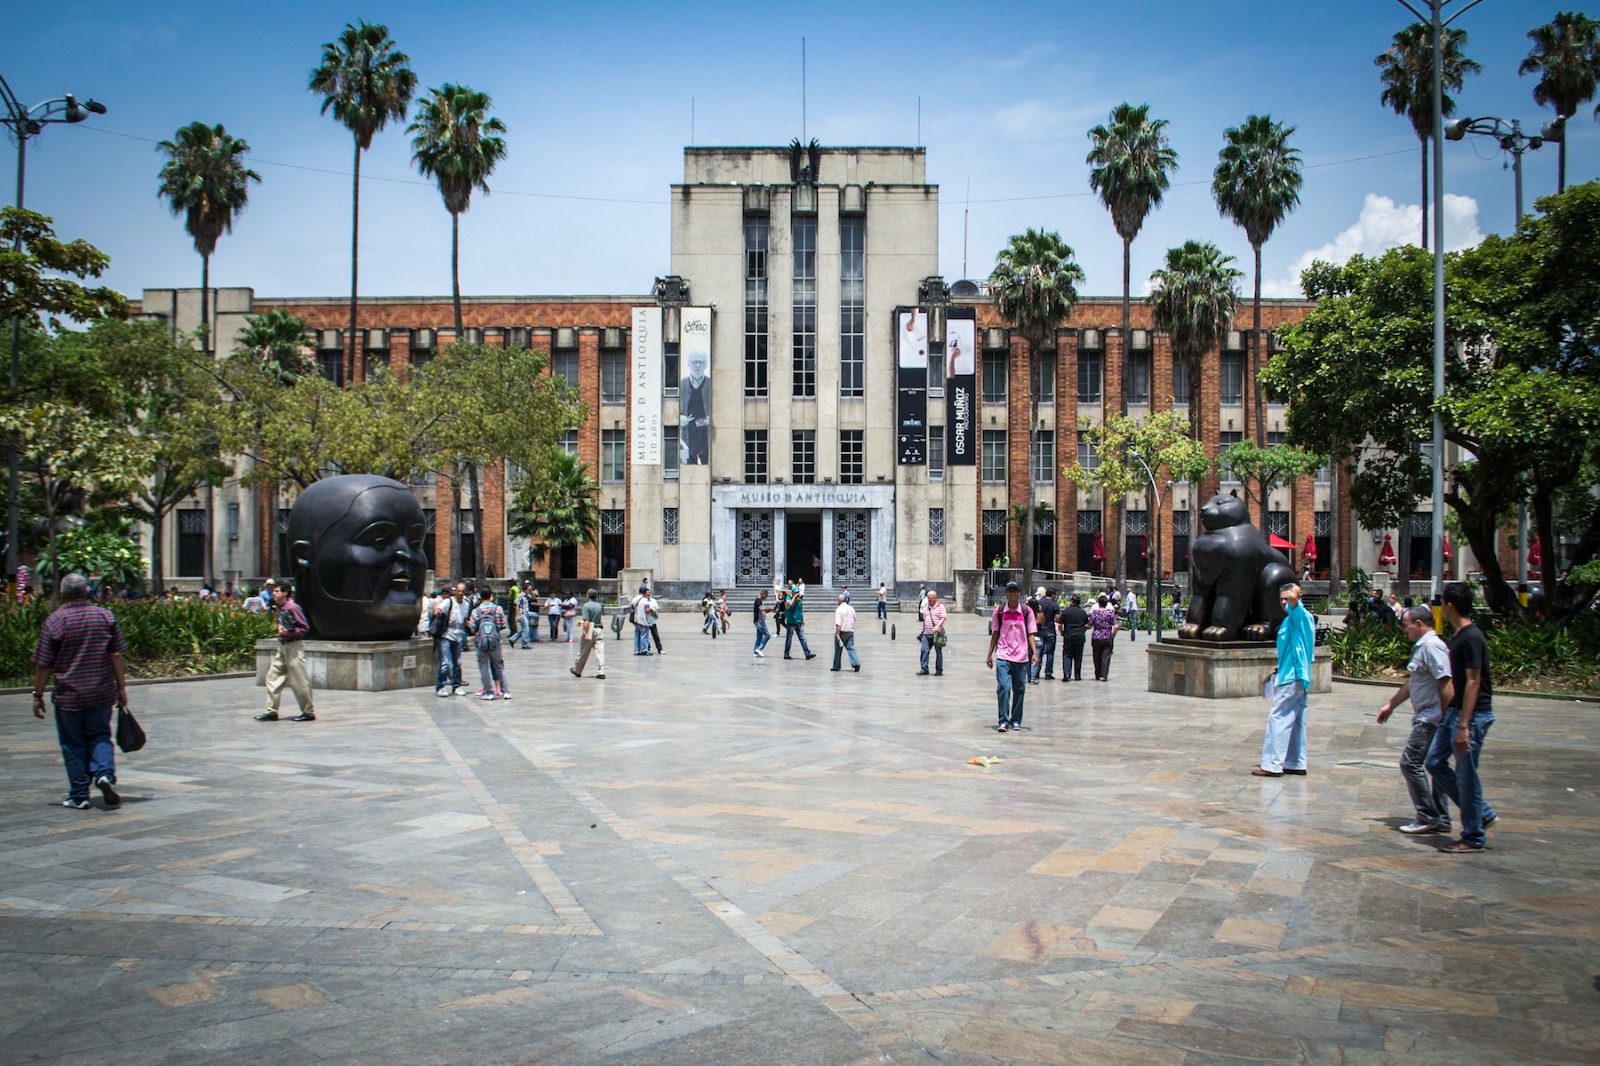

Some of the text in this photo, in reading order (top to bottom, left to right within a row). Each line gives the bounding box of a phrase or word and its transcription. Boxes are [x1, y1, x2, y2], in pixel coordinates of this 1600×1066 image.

[638, 310, 648, 389] ANTIOQUIA
[638, 415, 646, 460] MUSEO
[954, 387, 964, 455] OSCAR MUÑOZ
